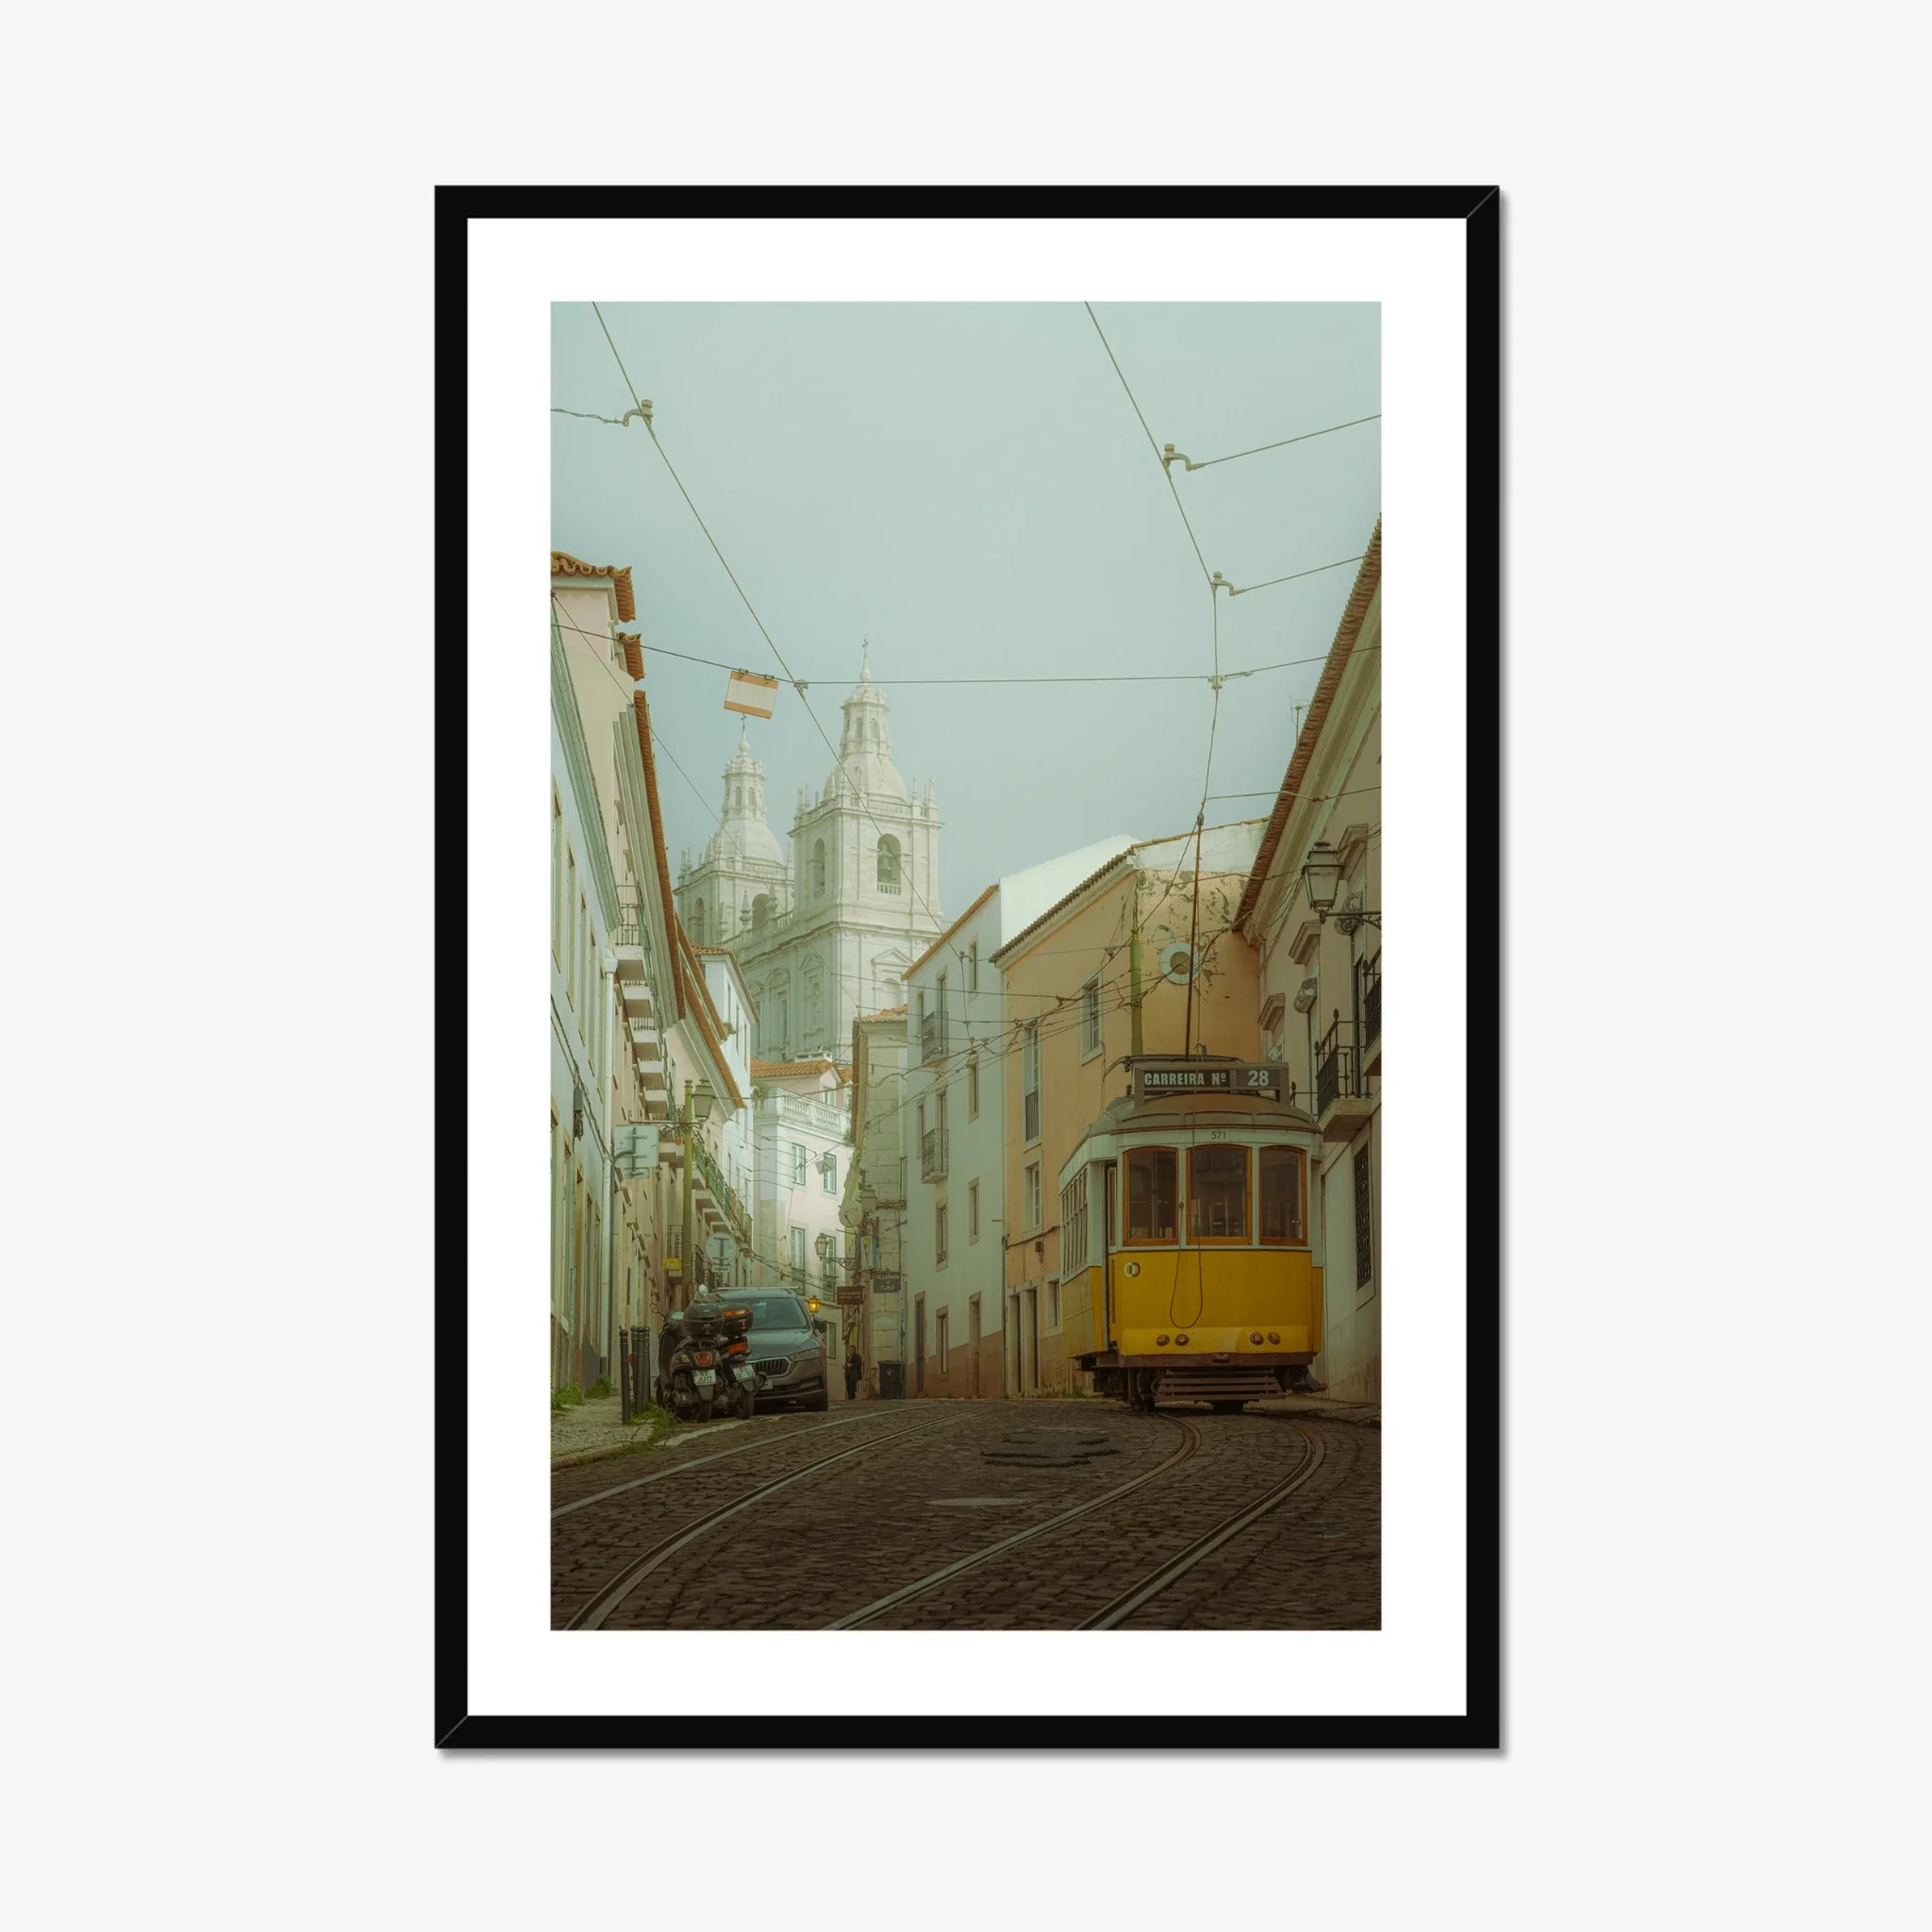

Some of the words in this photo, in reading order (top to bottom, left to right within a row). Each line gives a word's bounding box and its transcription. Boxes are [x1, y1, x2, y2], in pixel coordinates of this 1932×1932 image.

[1144, 1073, 1205, 1086] CARREIRA
[1248, 1070, 1269, 1087] 28
[1211, 1131, 1226, 1140] 571
